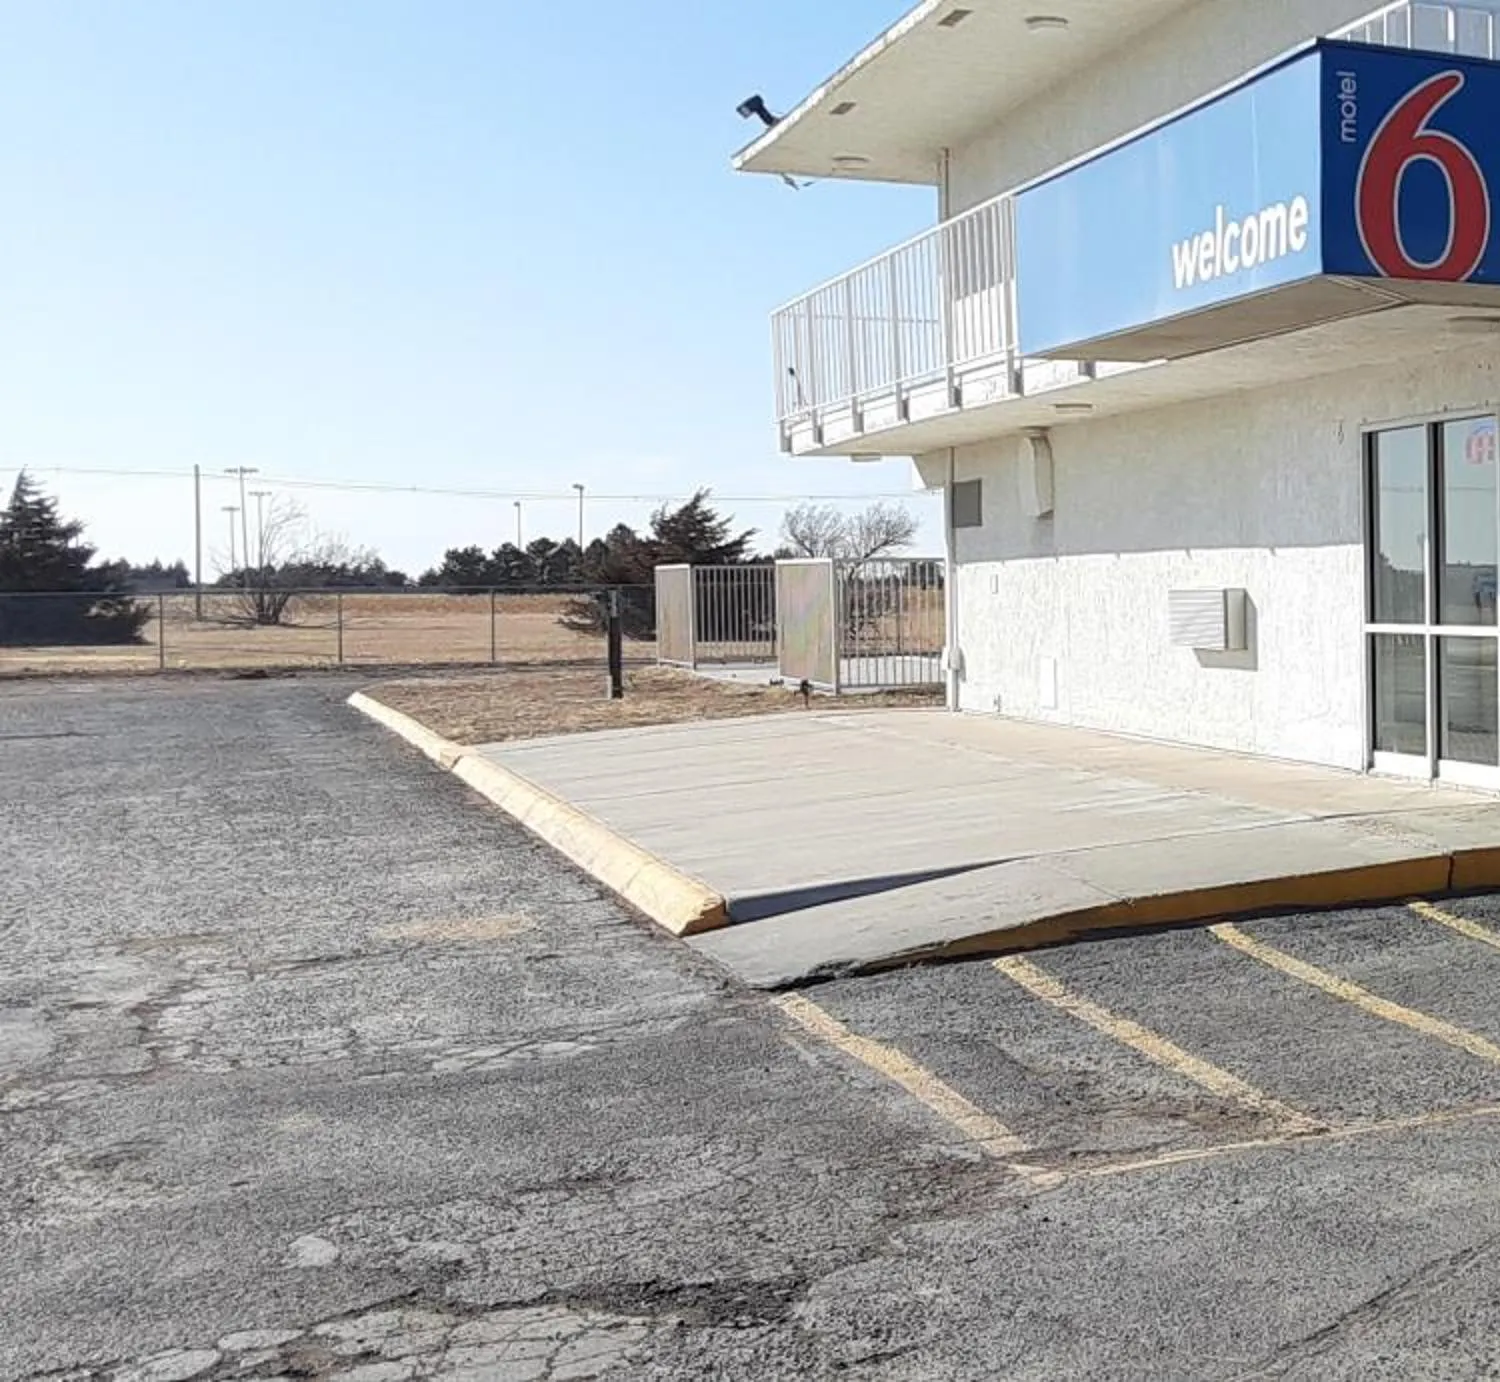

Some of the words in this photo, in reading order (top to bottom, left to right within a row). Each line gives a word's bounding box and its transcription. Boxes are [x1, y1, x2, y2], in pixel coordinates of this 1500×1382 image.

[1335, 71, 1357, 142] motel
[1354, 69, 1490, 282] 6
[1171, 195, 1309, 289] welcome
